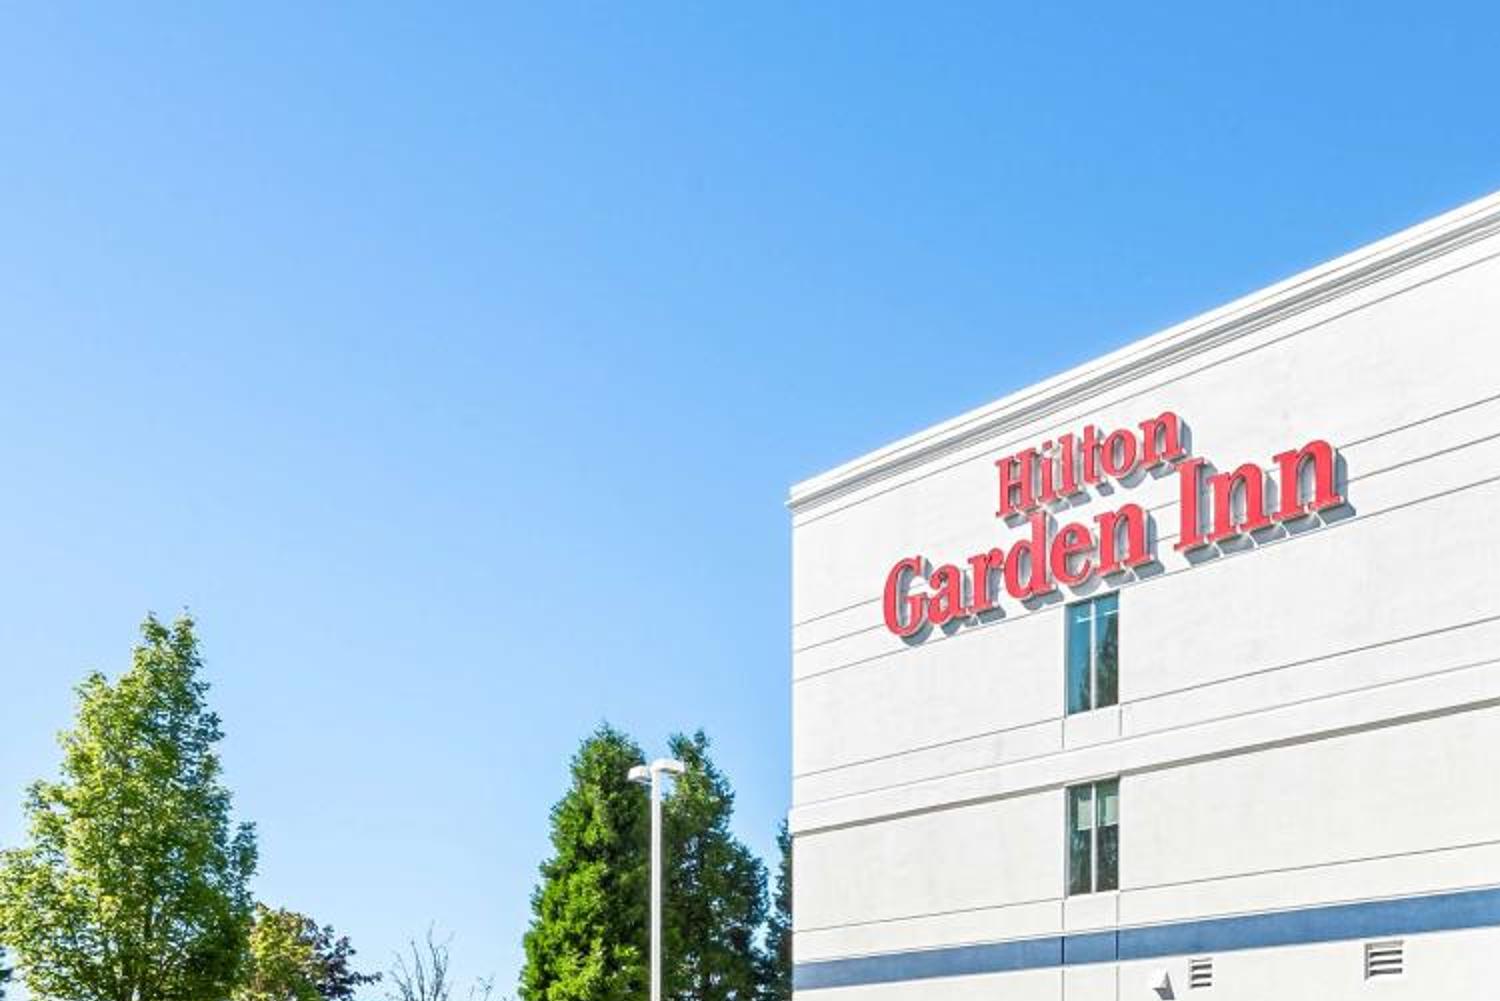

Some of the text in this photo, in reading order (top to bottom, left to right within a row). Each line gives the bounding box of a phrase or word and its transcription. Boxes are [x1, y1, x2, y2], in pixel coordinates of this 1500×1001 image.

[883, 439, 1346, 637] Garden Inn
[995, 411, 1186, 517] Hilton
